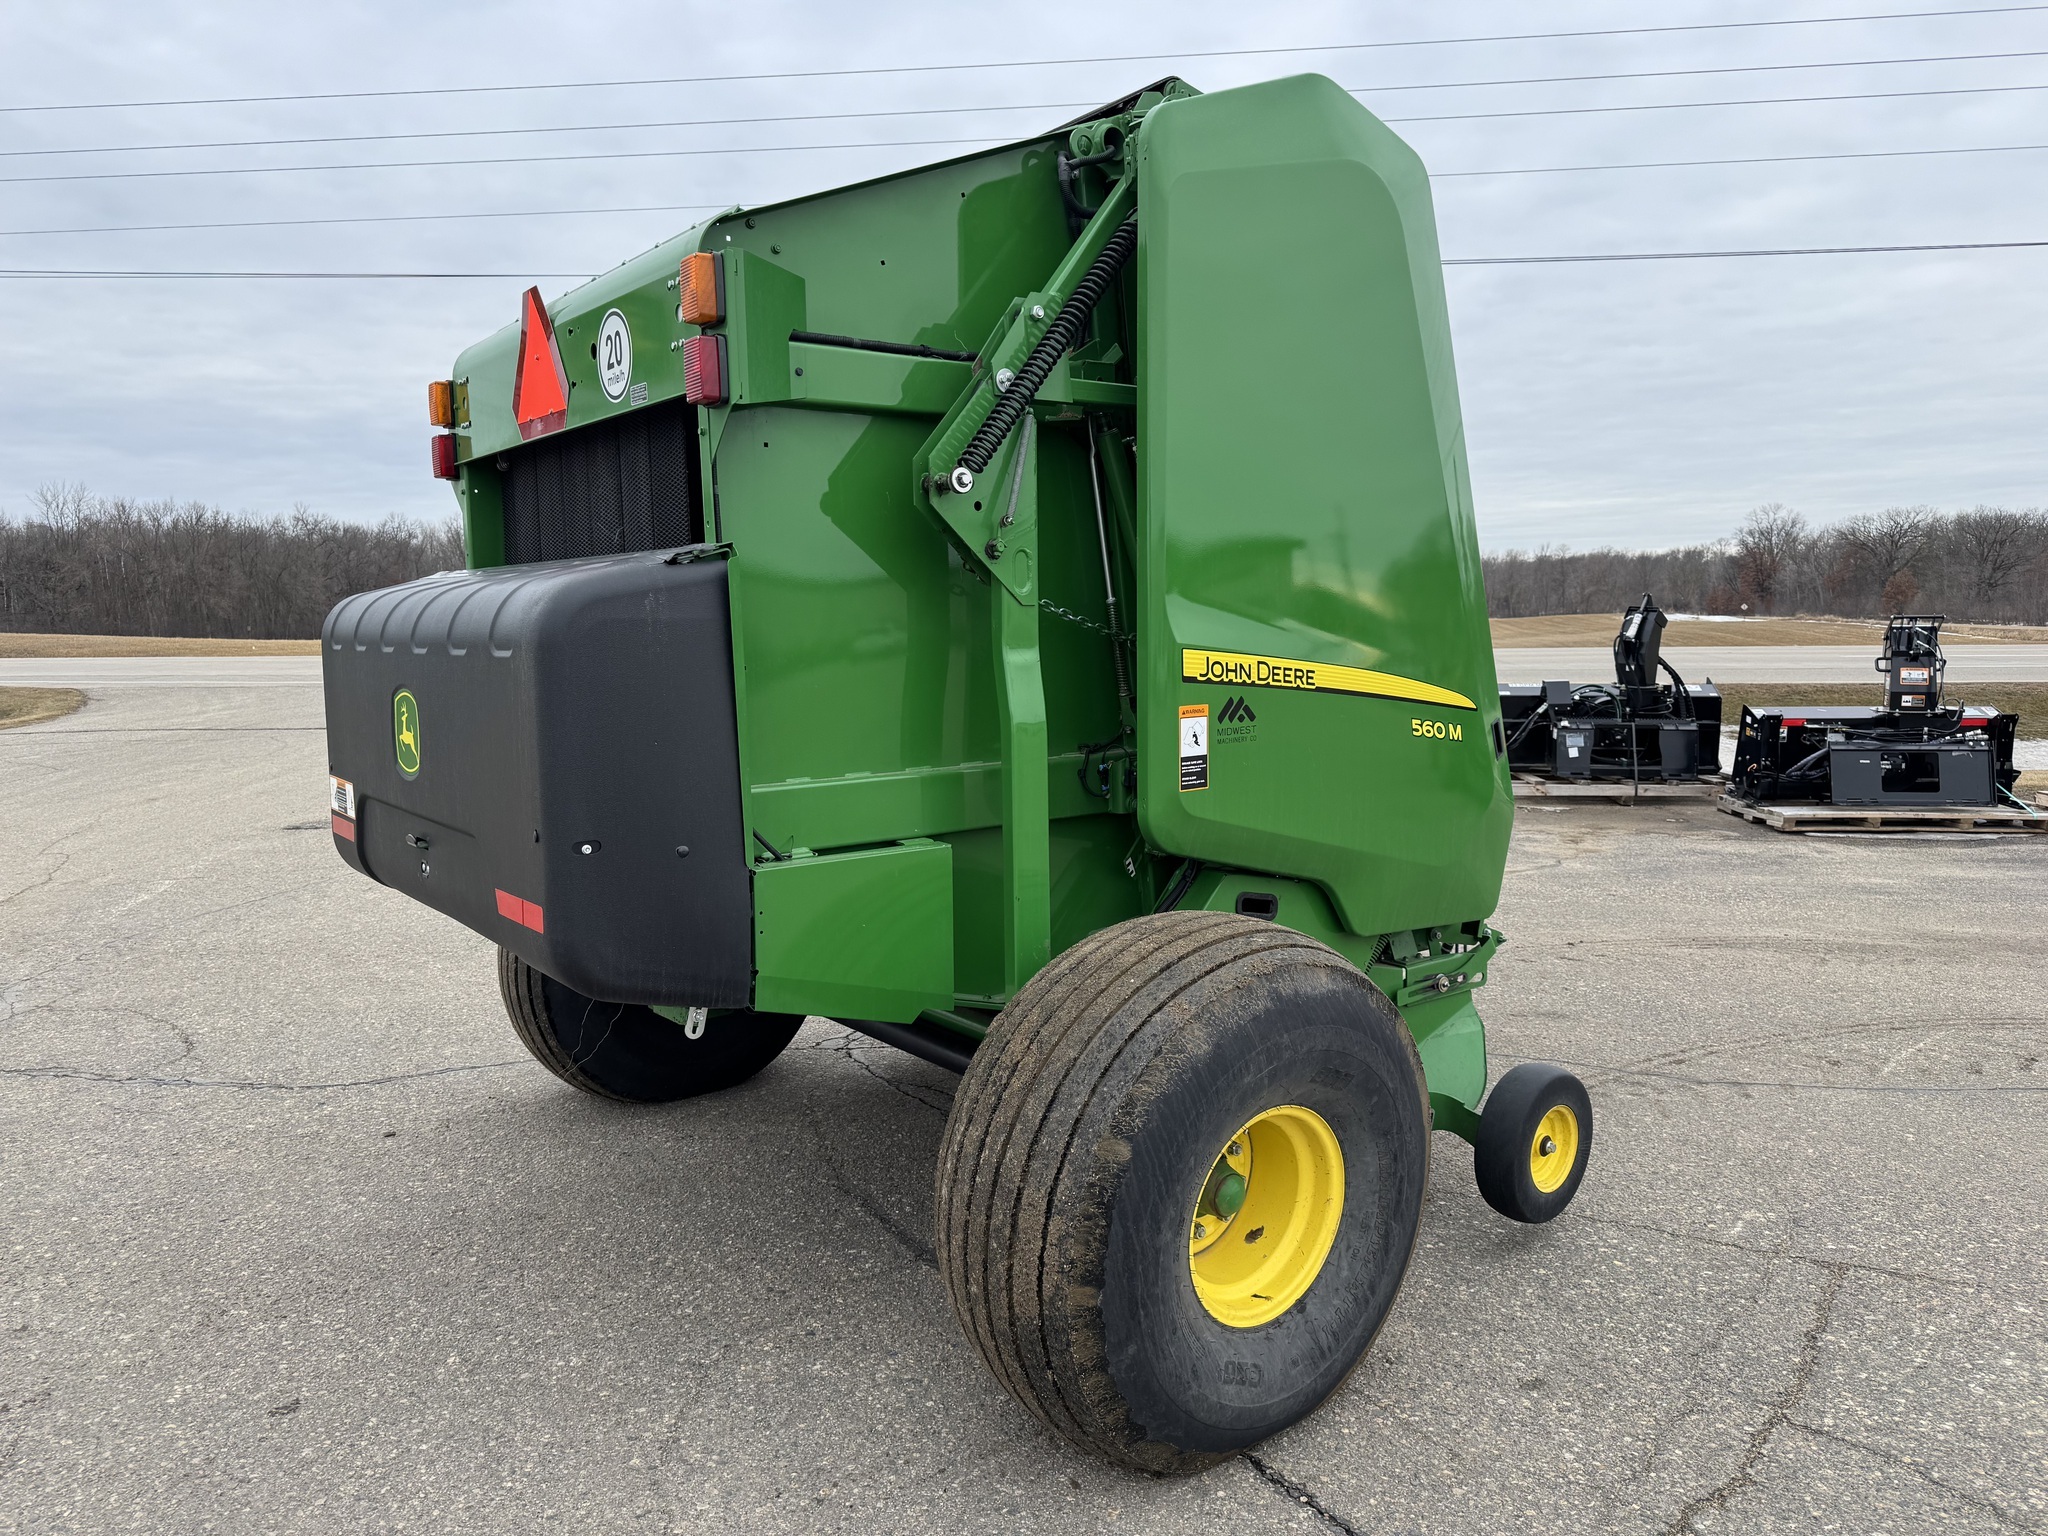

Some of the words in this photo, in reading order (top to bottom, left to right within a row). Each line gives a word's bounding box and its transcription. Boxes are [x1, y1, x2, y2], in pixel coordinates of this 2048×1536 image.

[606, 330, 623, 371] 20
[1199, 656, 1252, 681] JOHN
[1257, 660, 1316, 686] DEERE
[1217, 725, 1257, 736] MIDWEST
[1217, 736, 1247, 745] MACHINERY
[1411, 718, 1446, 739] 560
[1448, 723, 1463, 742] M
